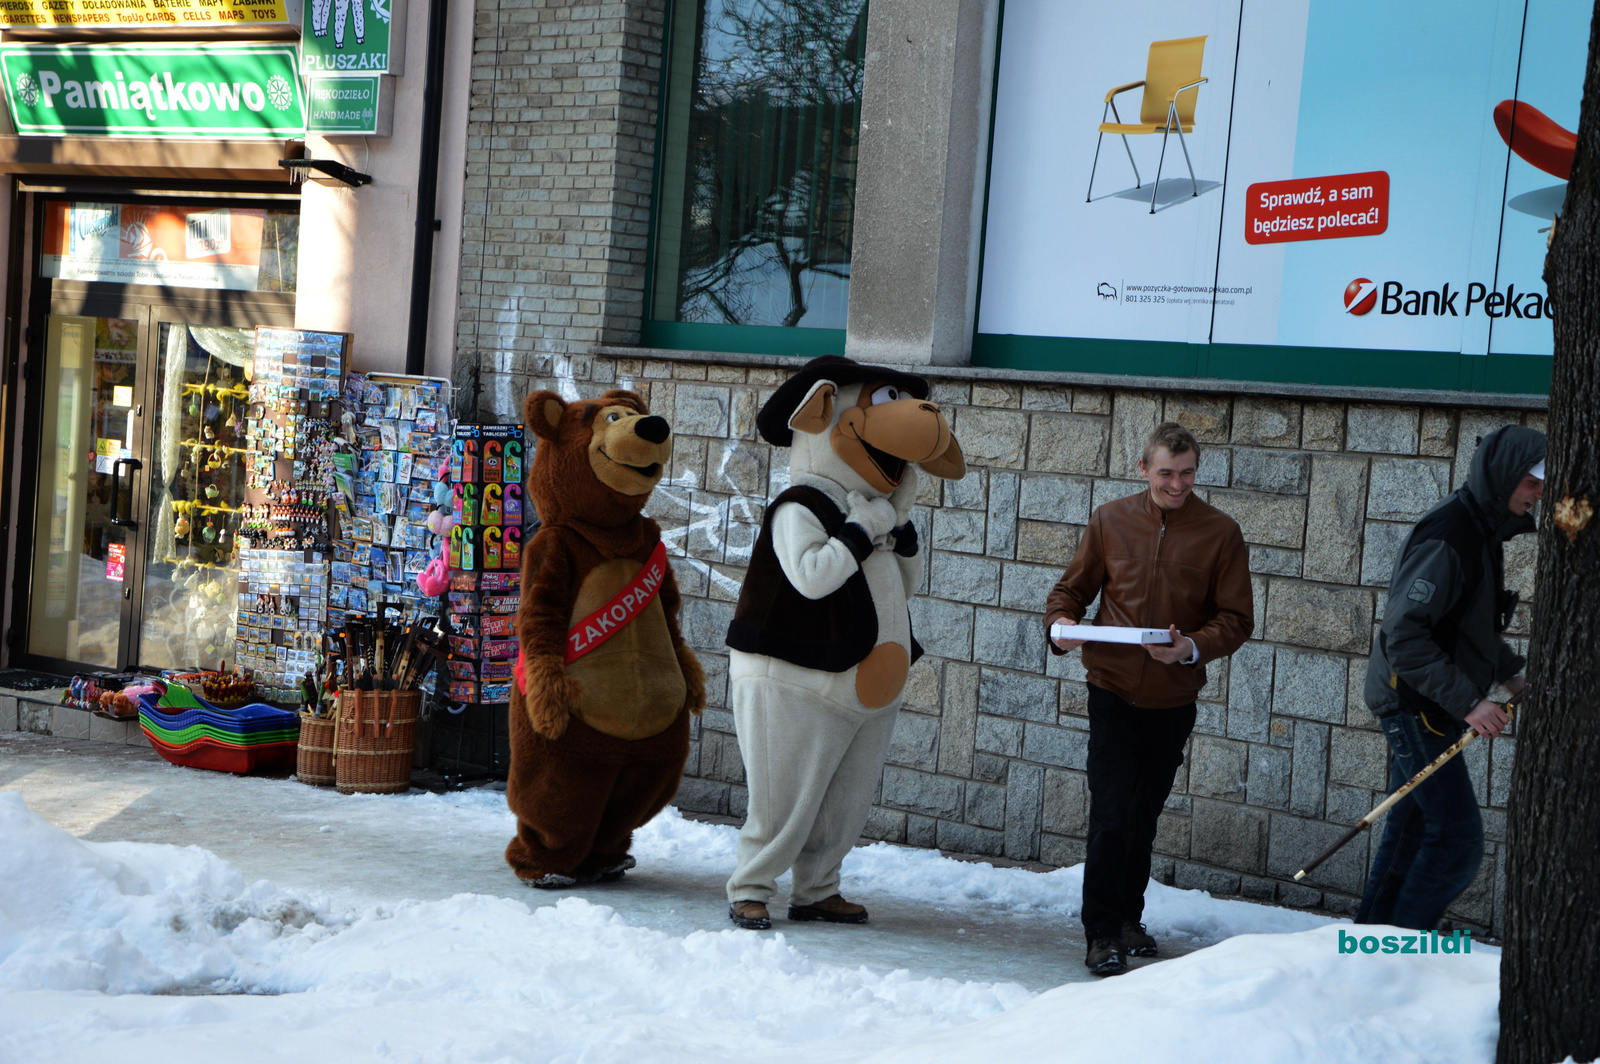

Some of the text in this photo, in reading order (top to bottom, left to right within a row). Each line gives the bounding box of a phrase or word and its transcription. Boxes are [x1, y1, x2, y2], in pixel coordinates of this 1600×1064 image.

[41, 0, 75, 10] GAZETY
[82, 0, 147, 10] DOŁADOWANIA
[154, 0, 191, 8] BATERIE
[53, 13, 111, 24] NEWSPAPERS
[116, 12, 144, 24] TopUp
[145, 12, 176, 22] CARDS
[183, 11, 212, 21] CELLS
[218, 10, 245, 20] MAPS
[251, 9, 277, 19] TOYS
[304, 52, 387, 70] PLUSZAKI
[38, 70, 266, 121] Pamiątkowo
[1260, 185, 1373, 211] Sprawdź, a sam
[1253, 207, 1379, 237] będziesz polecać!
[1125, 295, 1137, 303] 801
[1139, 295, 1152, 303] 325
[1152, 295, 1166, 304] 325
[1381, 280, 1460, 316] Bank
[569, 563, 662, 652] ZAKOPANE
